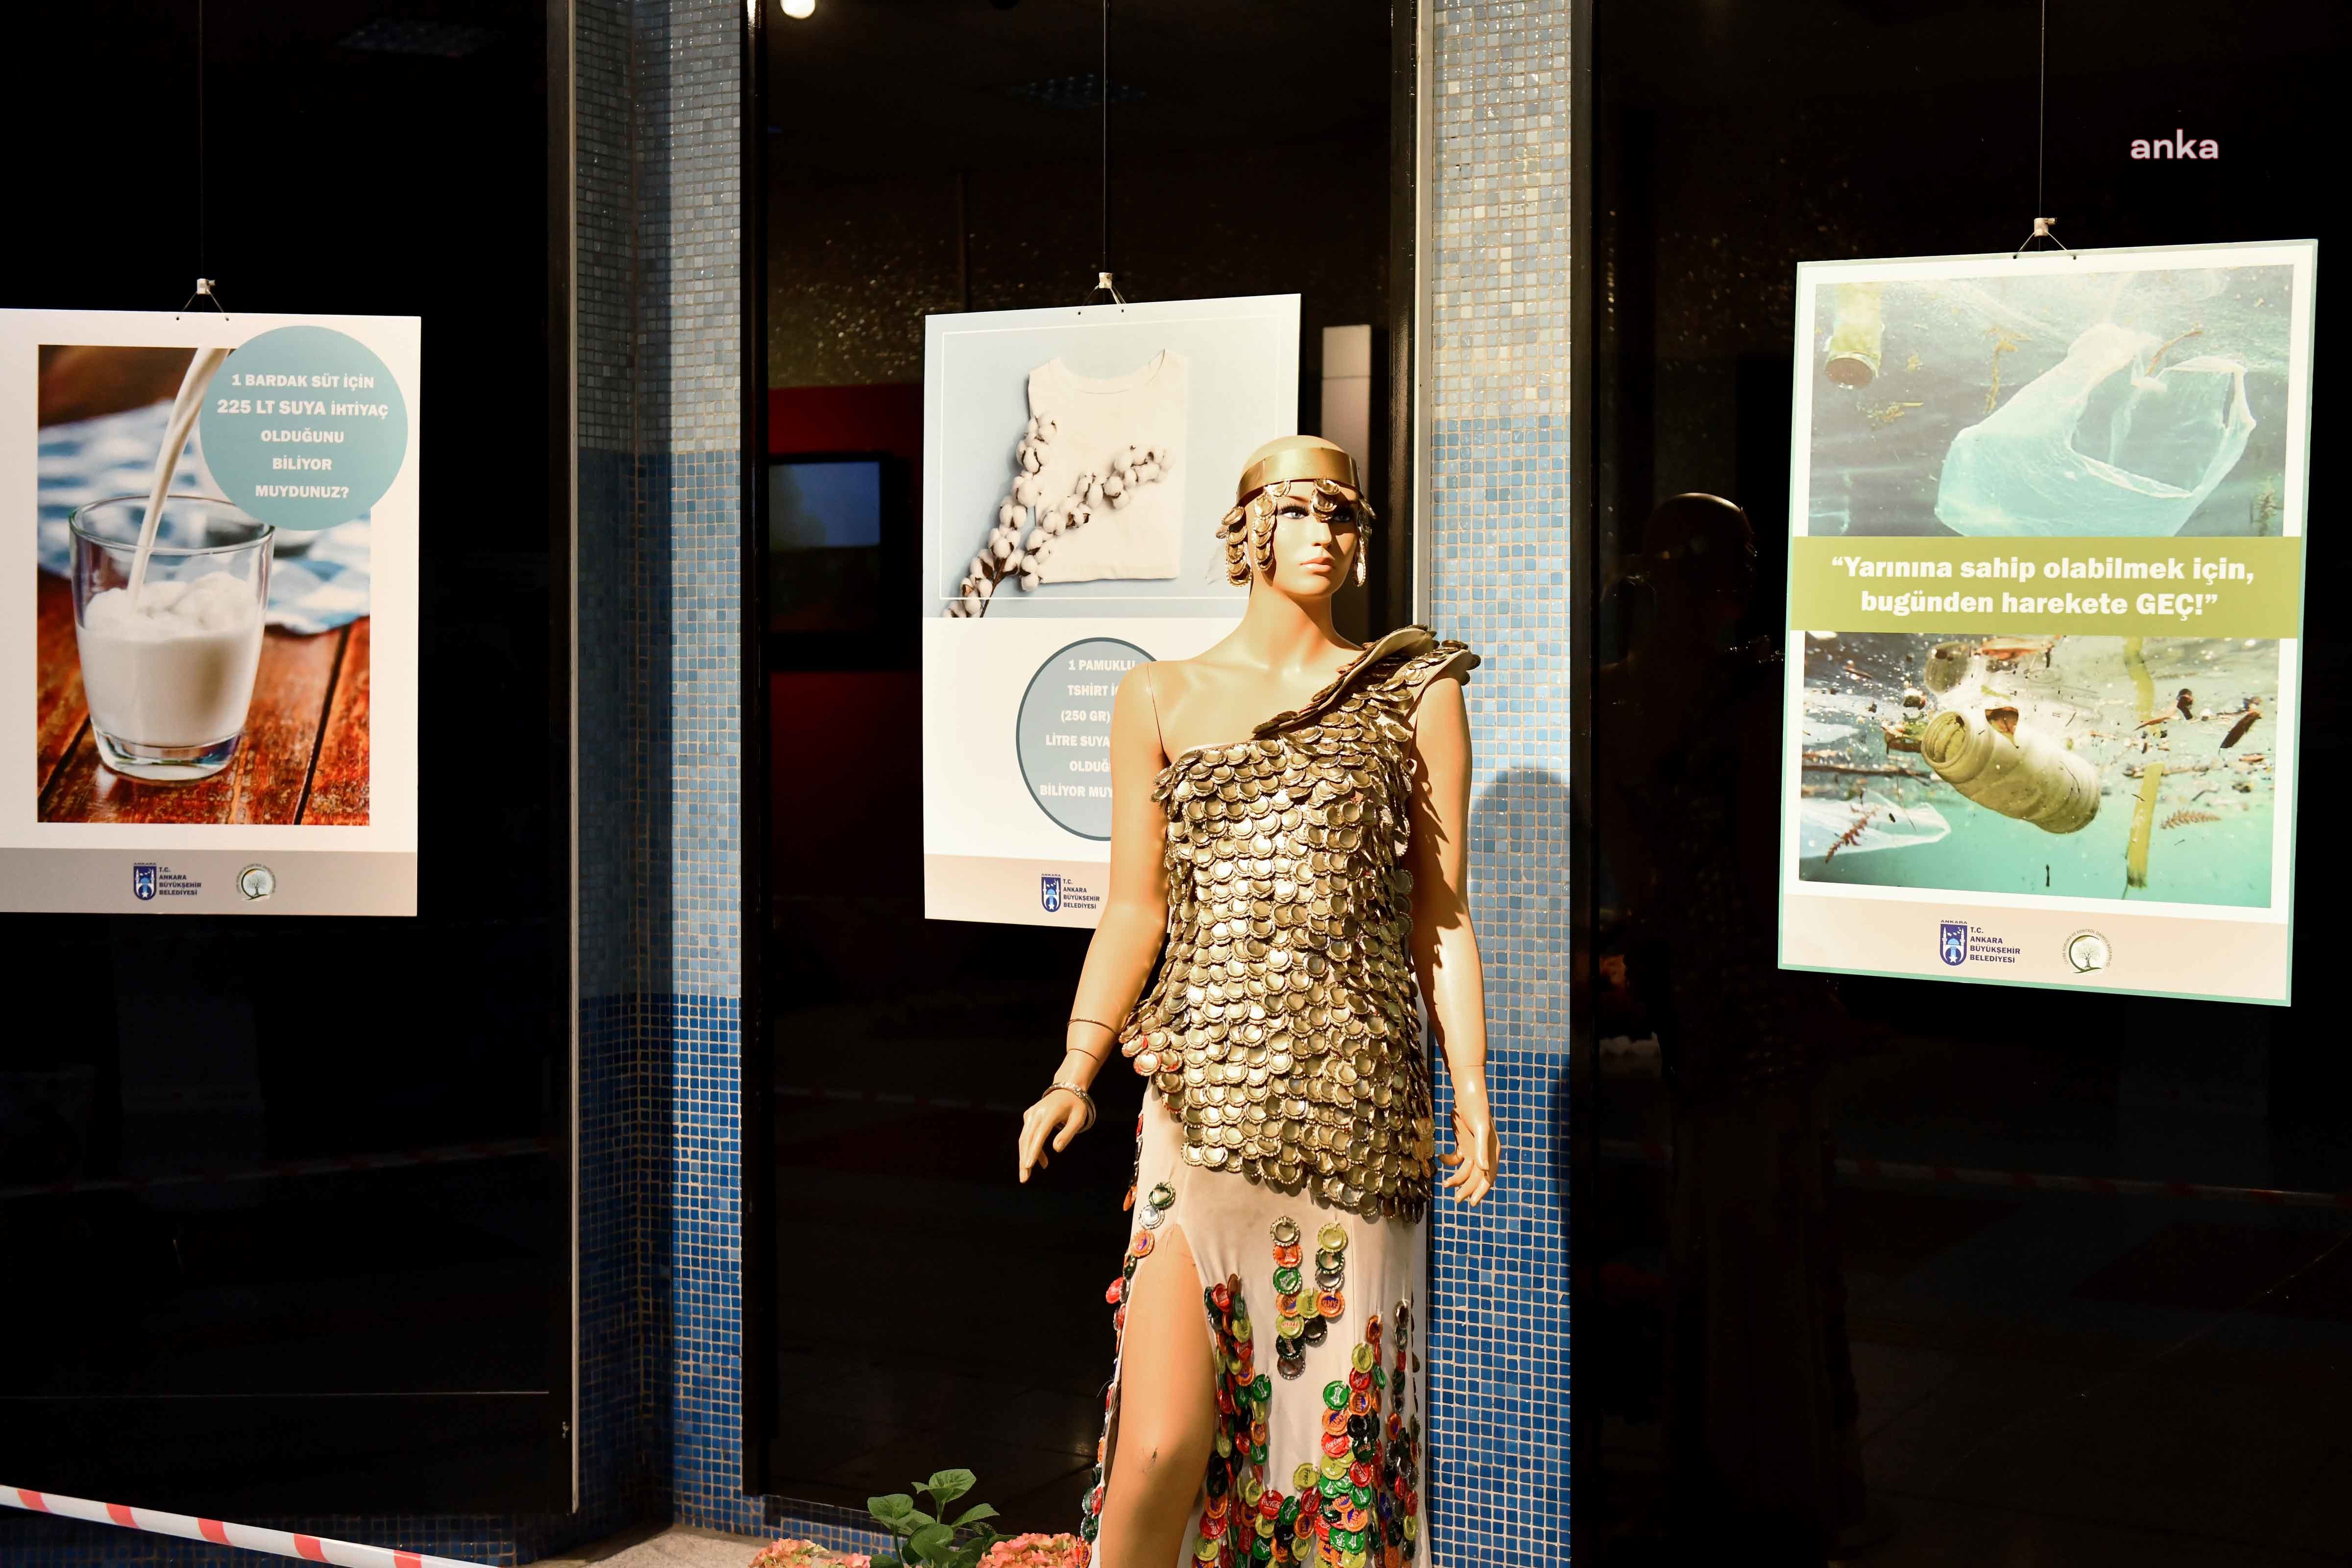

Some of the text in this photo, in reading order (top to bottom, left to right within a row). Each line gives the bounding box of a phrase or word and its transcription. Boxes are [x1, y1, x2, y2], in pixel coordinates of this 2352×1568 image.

[232, 373, 374, 391] 1 BARDAK SÜT İÇİN
[217, 399, 389, 420] 225 LT SUYA İHTİYAÇ
[261, 427, 344, 443] OLDUĞUNU
[272, 455, 333, 471] BİLİYOR
[255, 485, 350, 499] MUYDUNUZ?
[1960, 556, 2036, 583] sahip
[2043, 557, 2185, 580] olabilmek
[2193, 557, 2254, 585] için,
[1861, 590, 1994, 616] bugünden
[2002, 591, 2128, 615] harekete
[1068, 659, 1136, 671] 1 PAMUKLU
[1068, 683, 1108, 696] TSHİRT
[1061, 710, 1111, 724] (250 GR)
[1046, 733, 1078, 746] LİTRE
[1069, 758, 1110, 772] OLDUĞ
[1040, 783, 1085, 797] BİLİYOR
[1970, 936, 2003, 944] ANKARA
[1970, 944, 2020, 955] BÜYÜKŞEHİR
[1970, 954, 2015, 963] BELEDİYESİ
